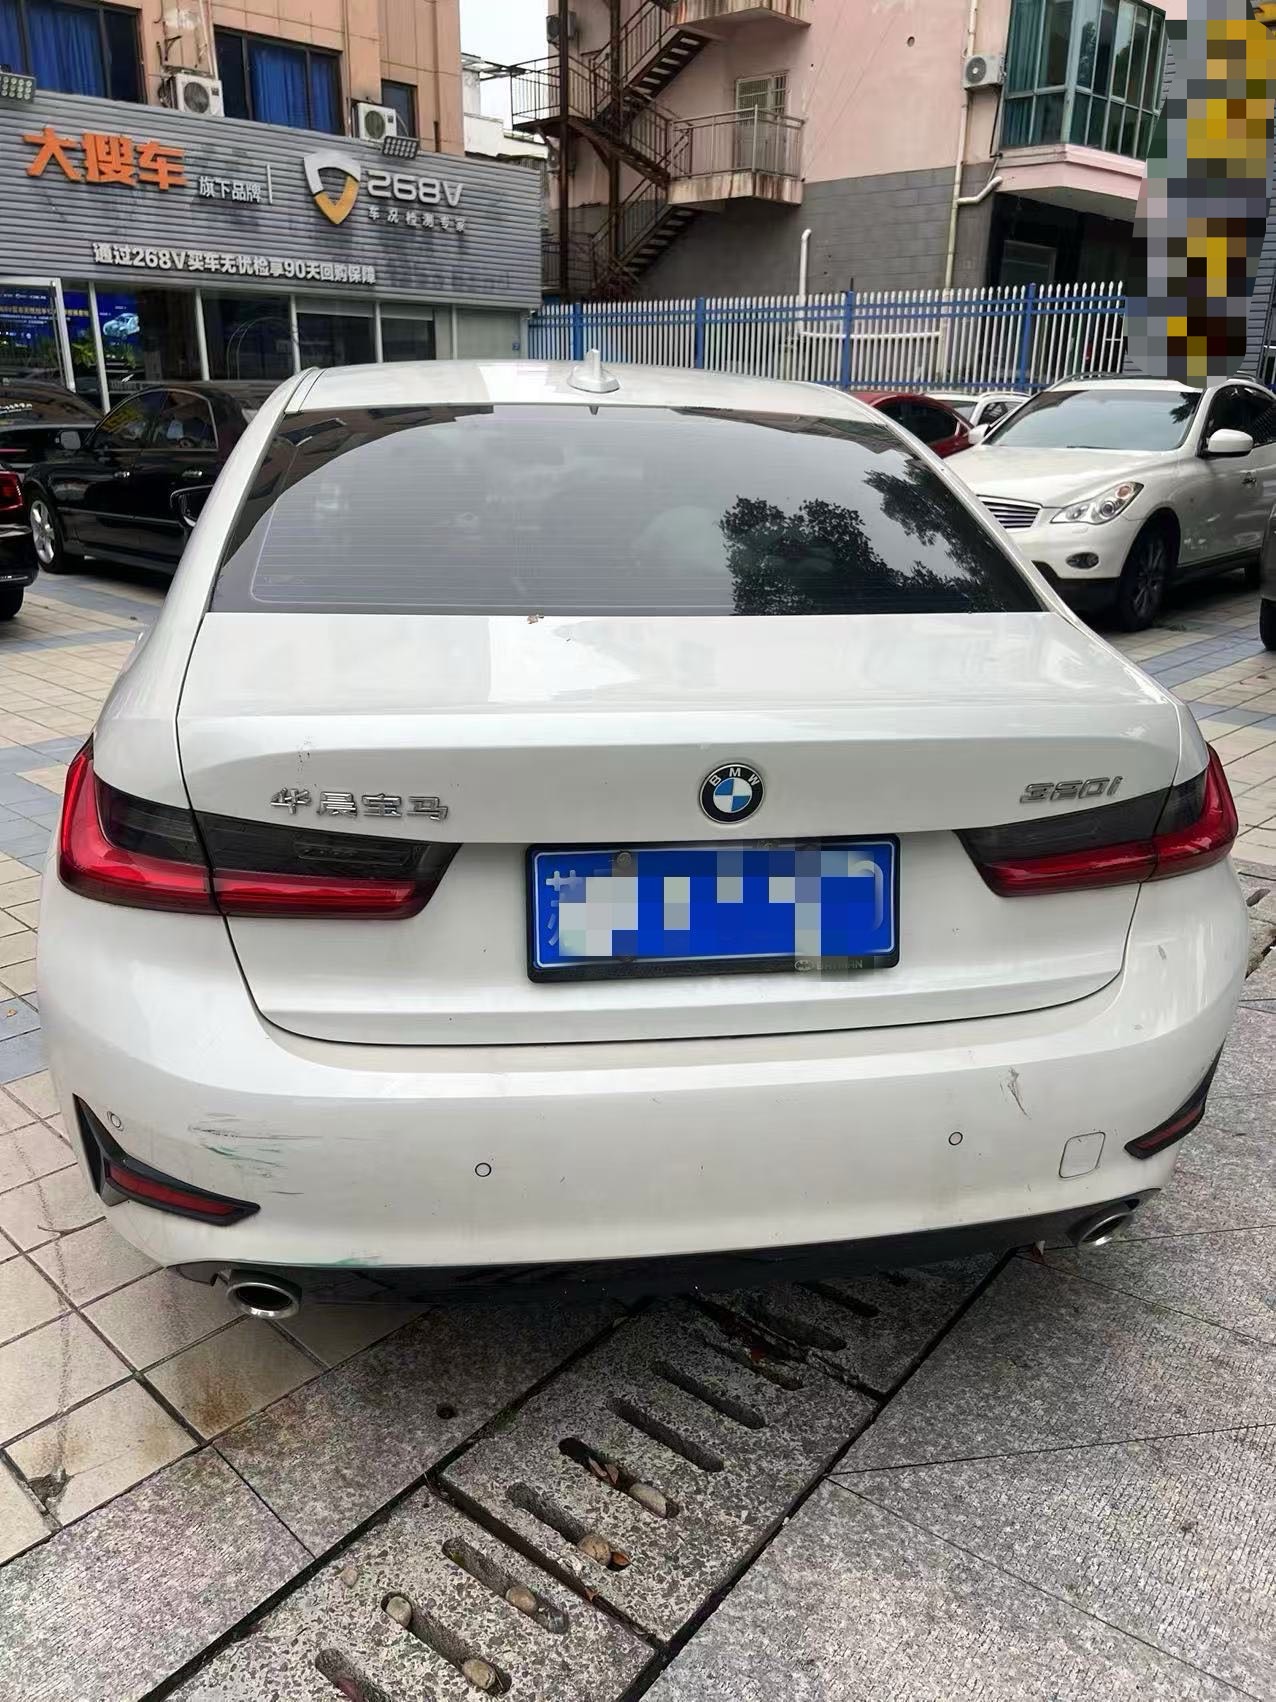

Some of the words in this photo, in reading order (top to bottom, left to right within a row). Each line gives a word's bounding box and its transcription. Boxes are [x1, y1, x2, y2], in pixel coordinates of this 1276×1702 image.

[22, 125, 189, 190] 大搜车
[199, 177, 263, 202] 旗下品牌
[366, 169, 464, 207] 268V
[709, 767, 760, 787] BMW
[270, 787, 449, 821] 华晨宝马
